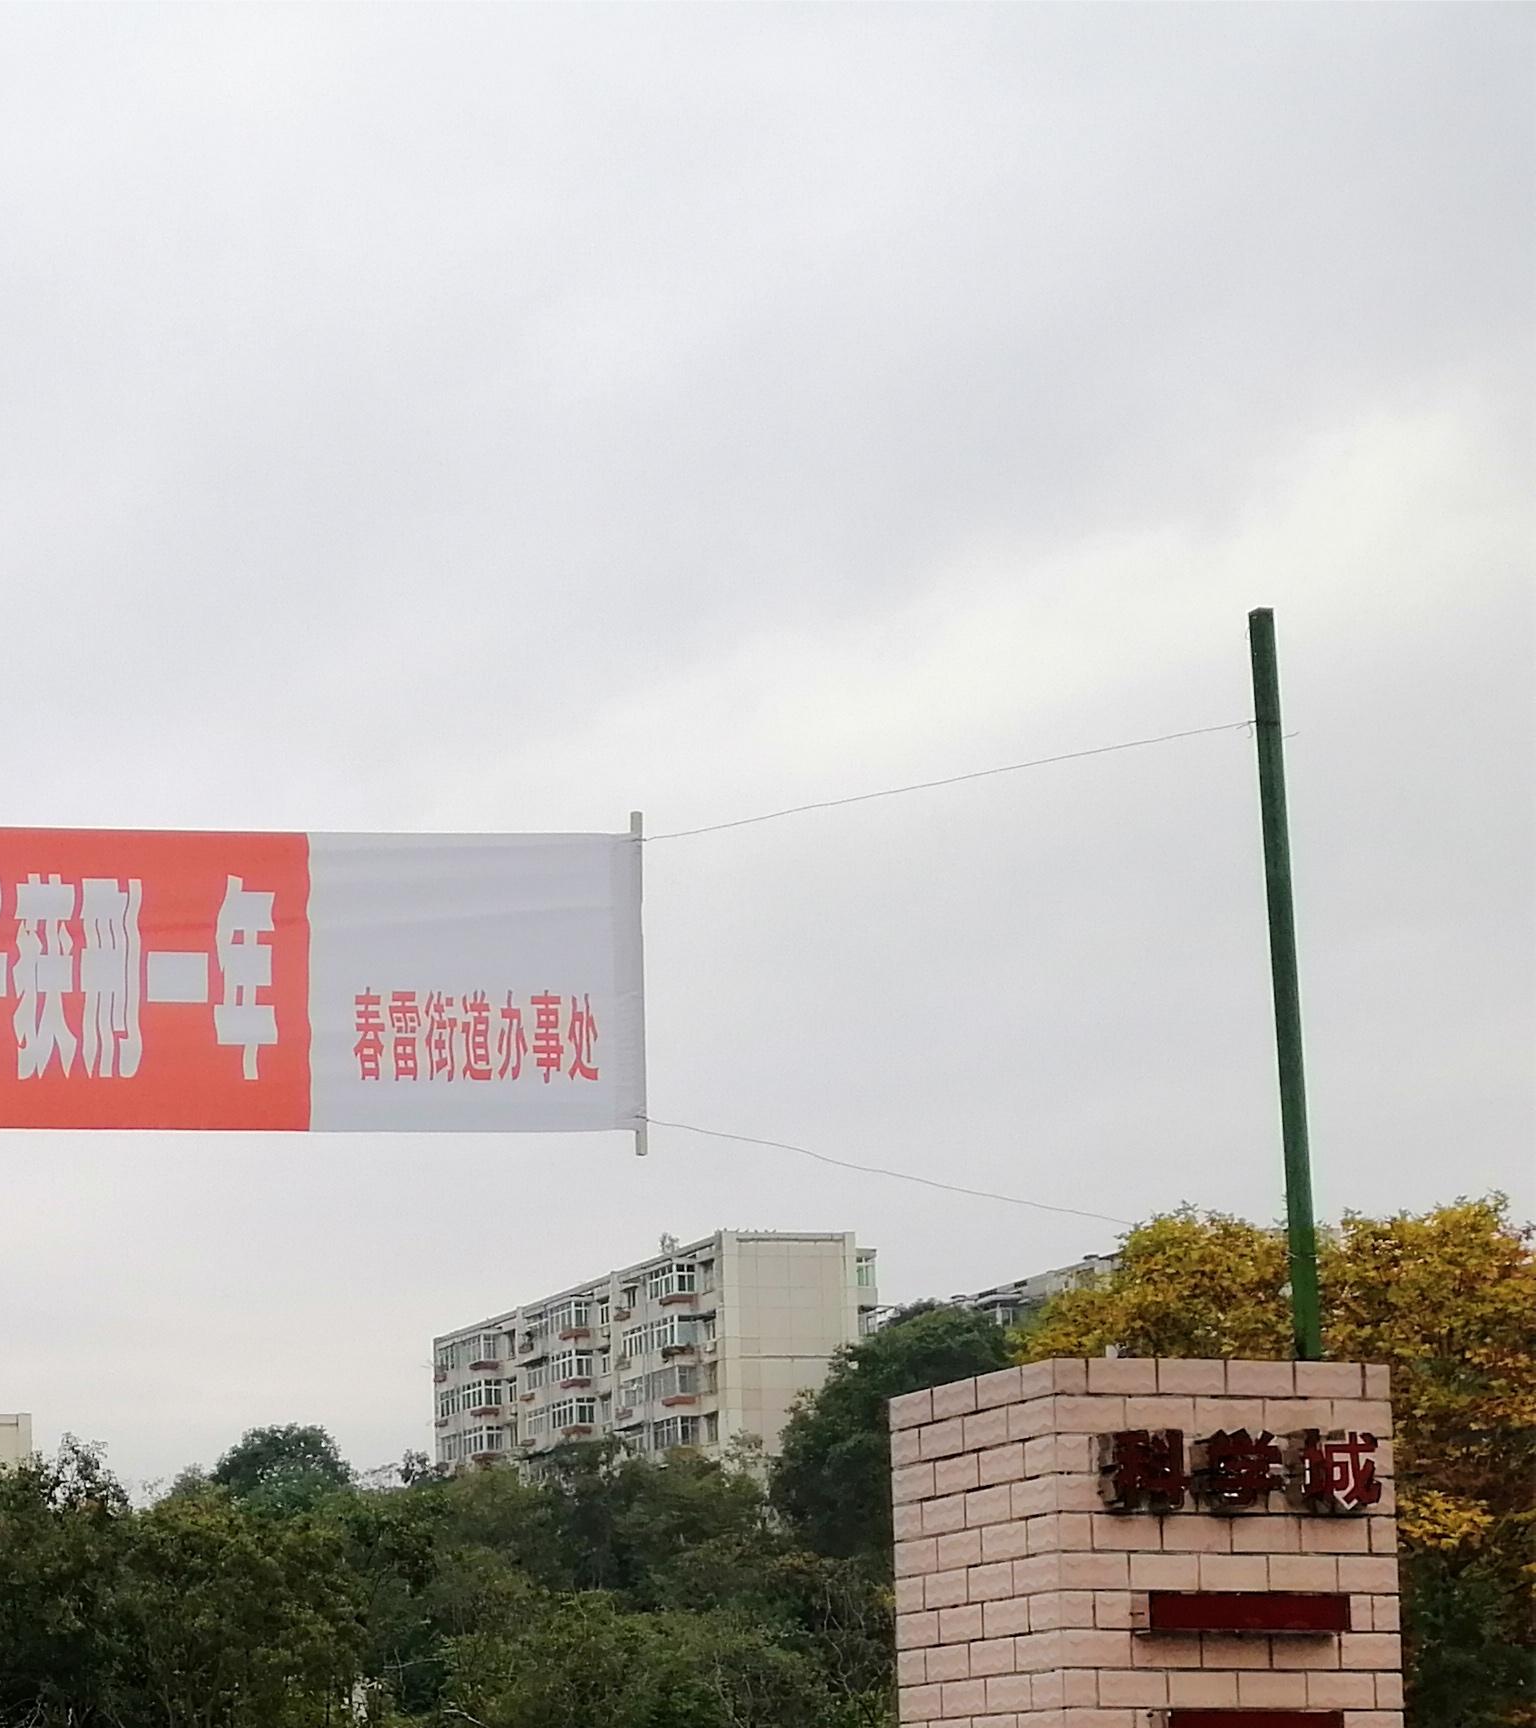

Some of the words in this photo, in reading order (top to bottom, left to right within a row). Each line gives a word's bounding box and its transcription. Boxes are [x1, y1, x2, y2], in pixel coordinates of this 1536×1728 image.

[352, 985, 601, 1085] 春雷街道办事处
[1098, 1427, 1382, 1511] 科学城
